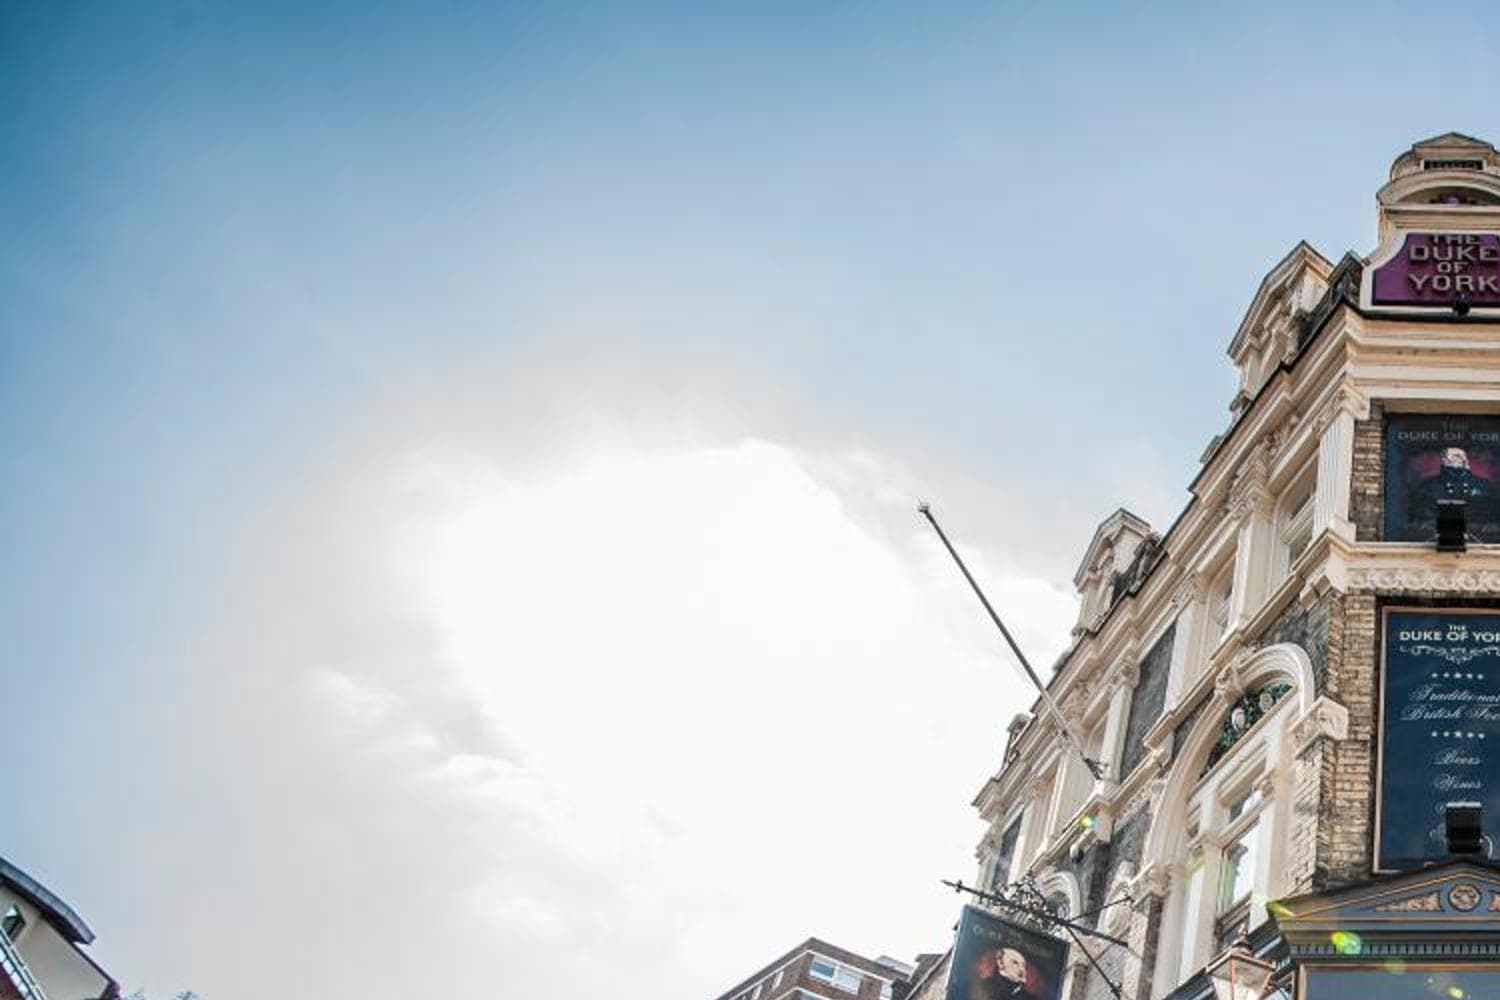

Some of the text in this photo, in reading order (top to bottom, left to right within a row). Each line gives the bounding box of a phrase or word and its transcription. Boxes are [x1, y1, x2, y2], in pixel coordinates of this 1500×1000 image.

[1432, 234, 1480, 244] THE
[1409, 245, 1499, 261] DUKE
[1437, 262, 1469, 273] OF
[1408, 274, 1500, 292] YORK
[1397, 431, 1439, 442] DUKE
[1443, 431, 1464, 442] OF
[1399, 631, 1443, 642] DUKE
[1446, 631, 1469, 642] OF
[1401, 704, 1466, 721] British
